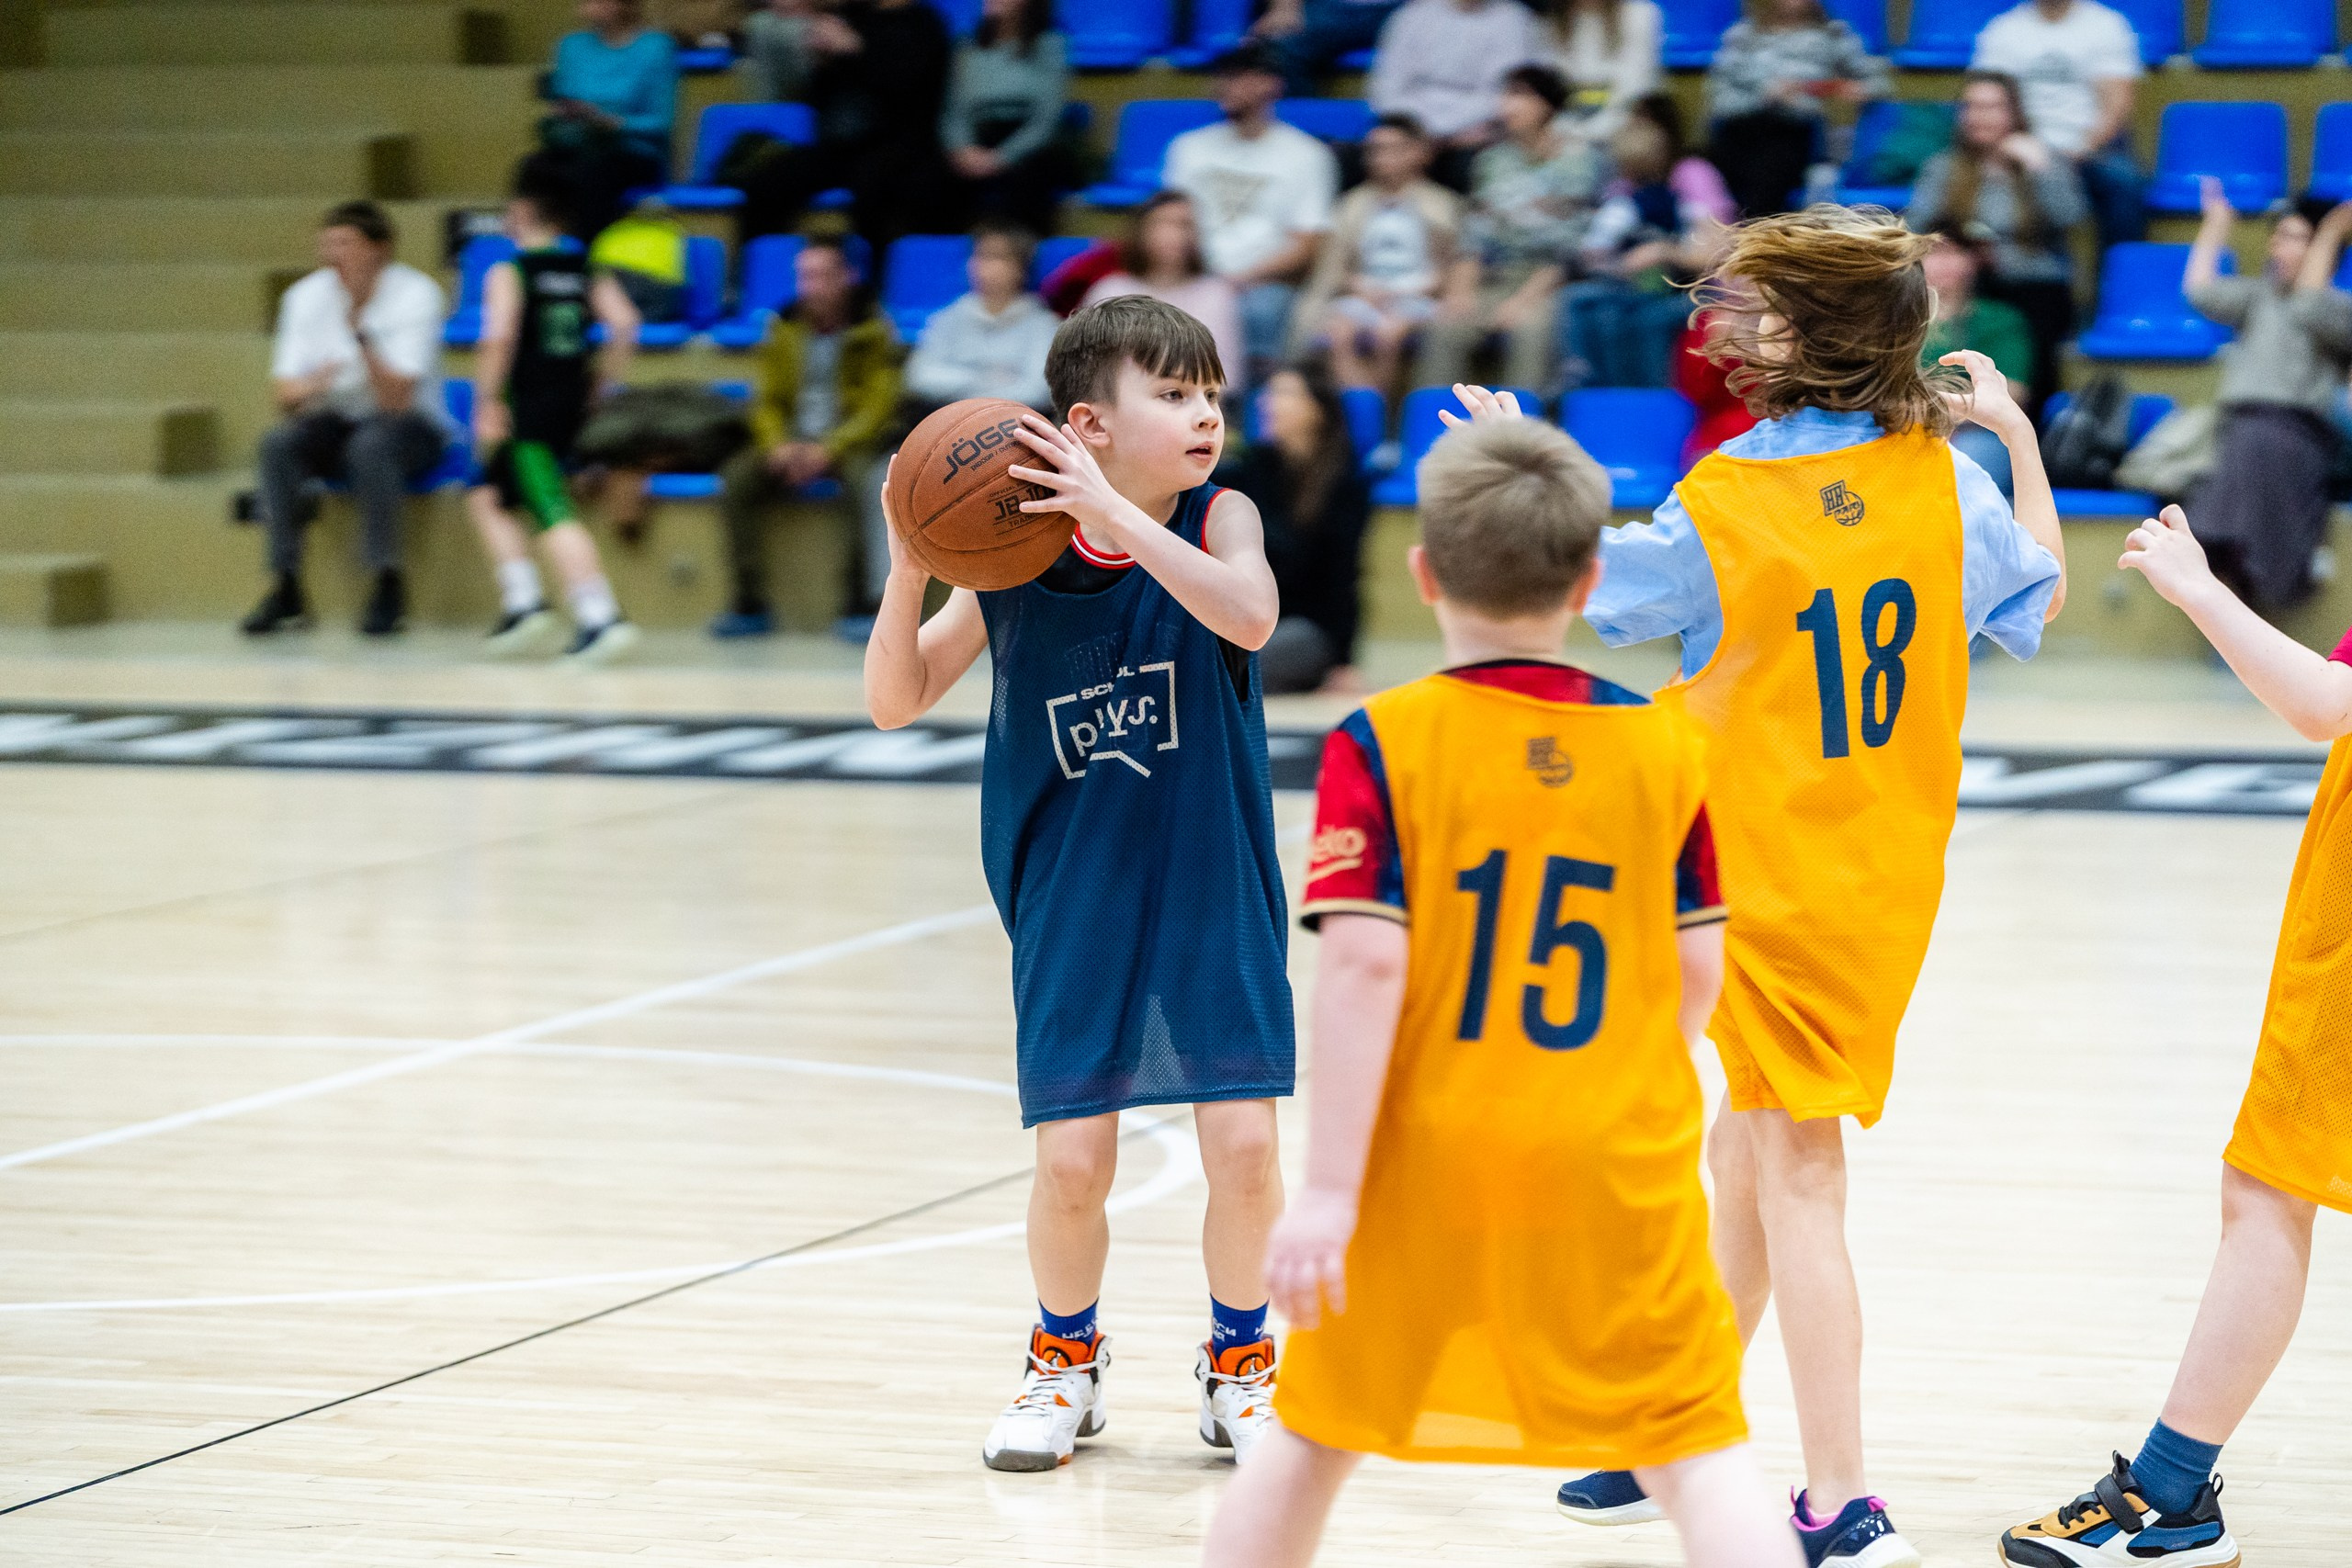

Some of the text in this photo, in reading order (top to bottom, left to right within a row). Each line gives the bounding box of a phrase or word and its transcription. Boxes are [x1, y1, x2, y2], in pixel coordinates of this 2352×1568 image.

[943, 418, 1020, 485] JÖGE
[1795, 577, 1917, 759] 18
[1456, 848, 1615, 1052] 15
